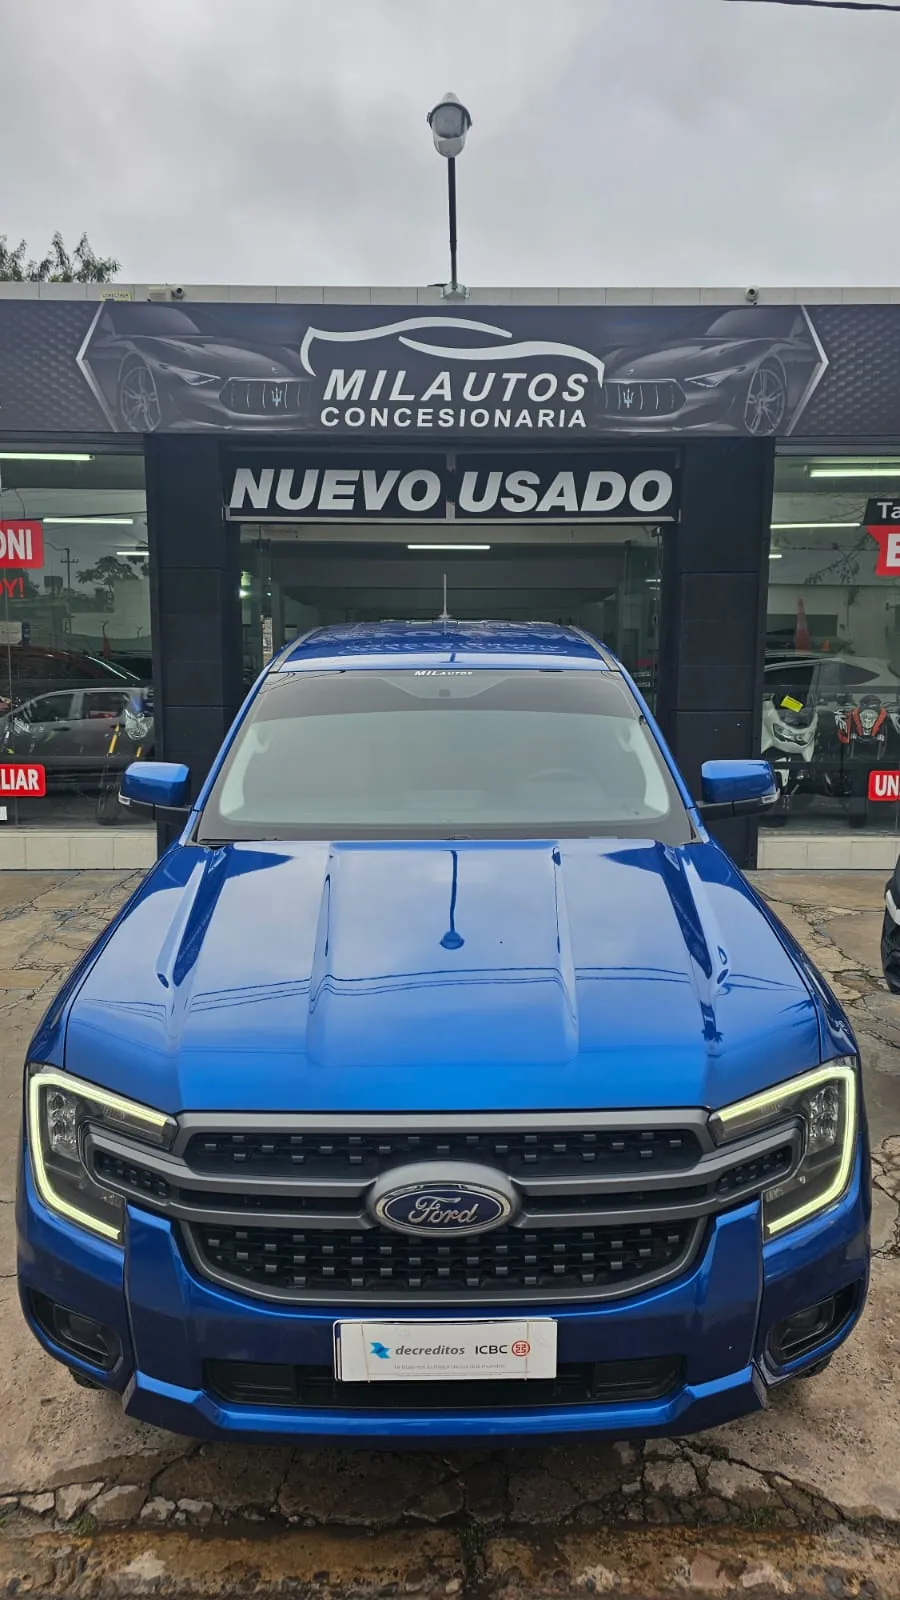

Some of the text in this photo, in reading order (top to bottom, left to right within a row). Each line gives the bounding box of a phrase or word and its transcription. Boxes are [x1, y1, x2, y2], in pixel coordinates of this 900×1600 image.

[323, 368, 589, 403] MILAUTOS
[320, 407, 587, 428] CONCESIONARIA
[229, 468, 673, 513] NUEVO USADO
[407, 1195, 480, 1224] Ford
[395, 1344, 508, 1356] decreditos ICBC
